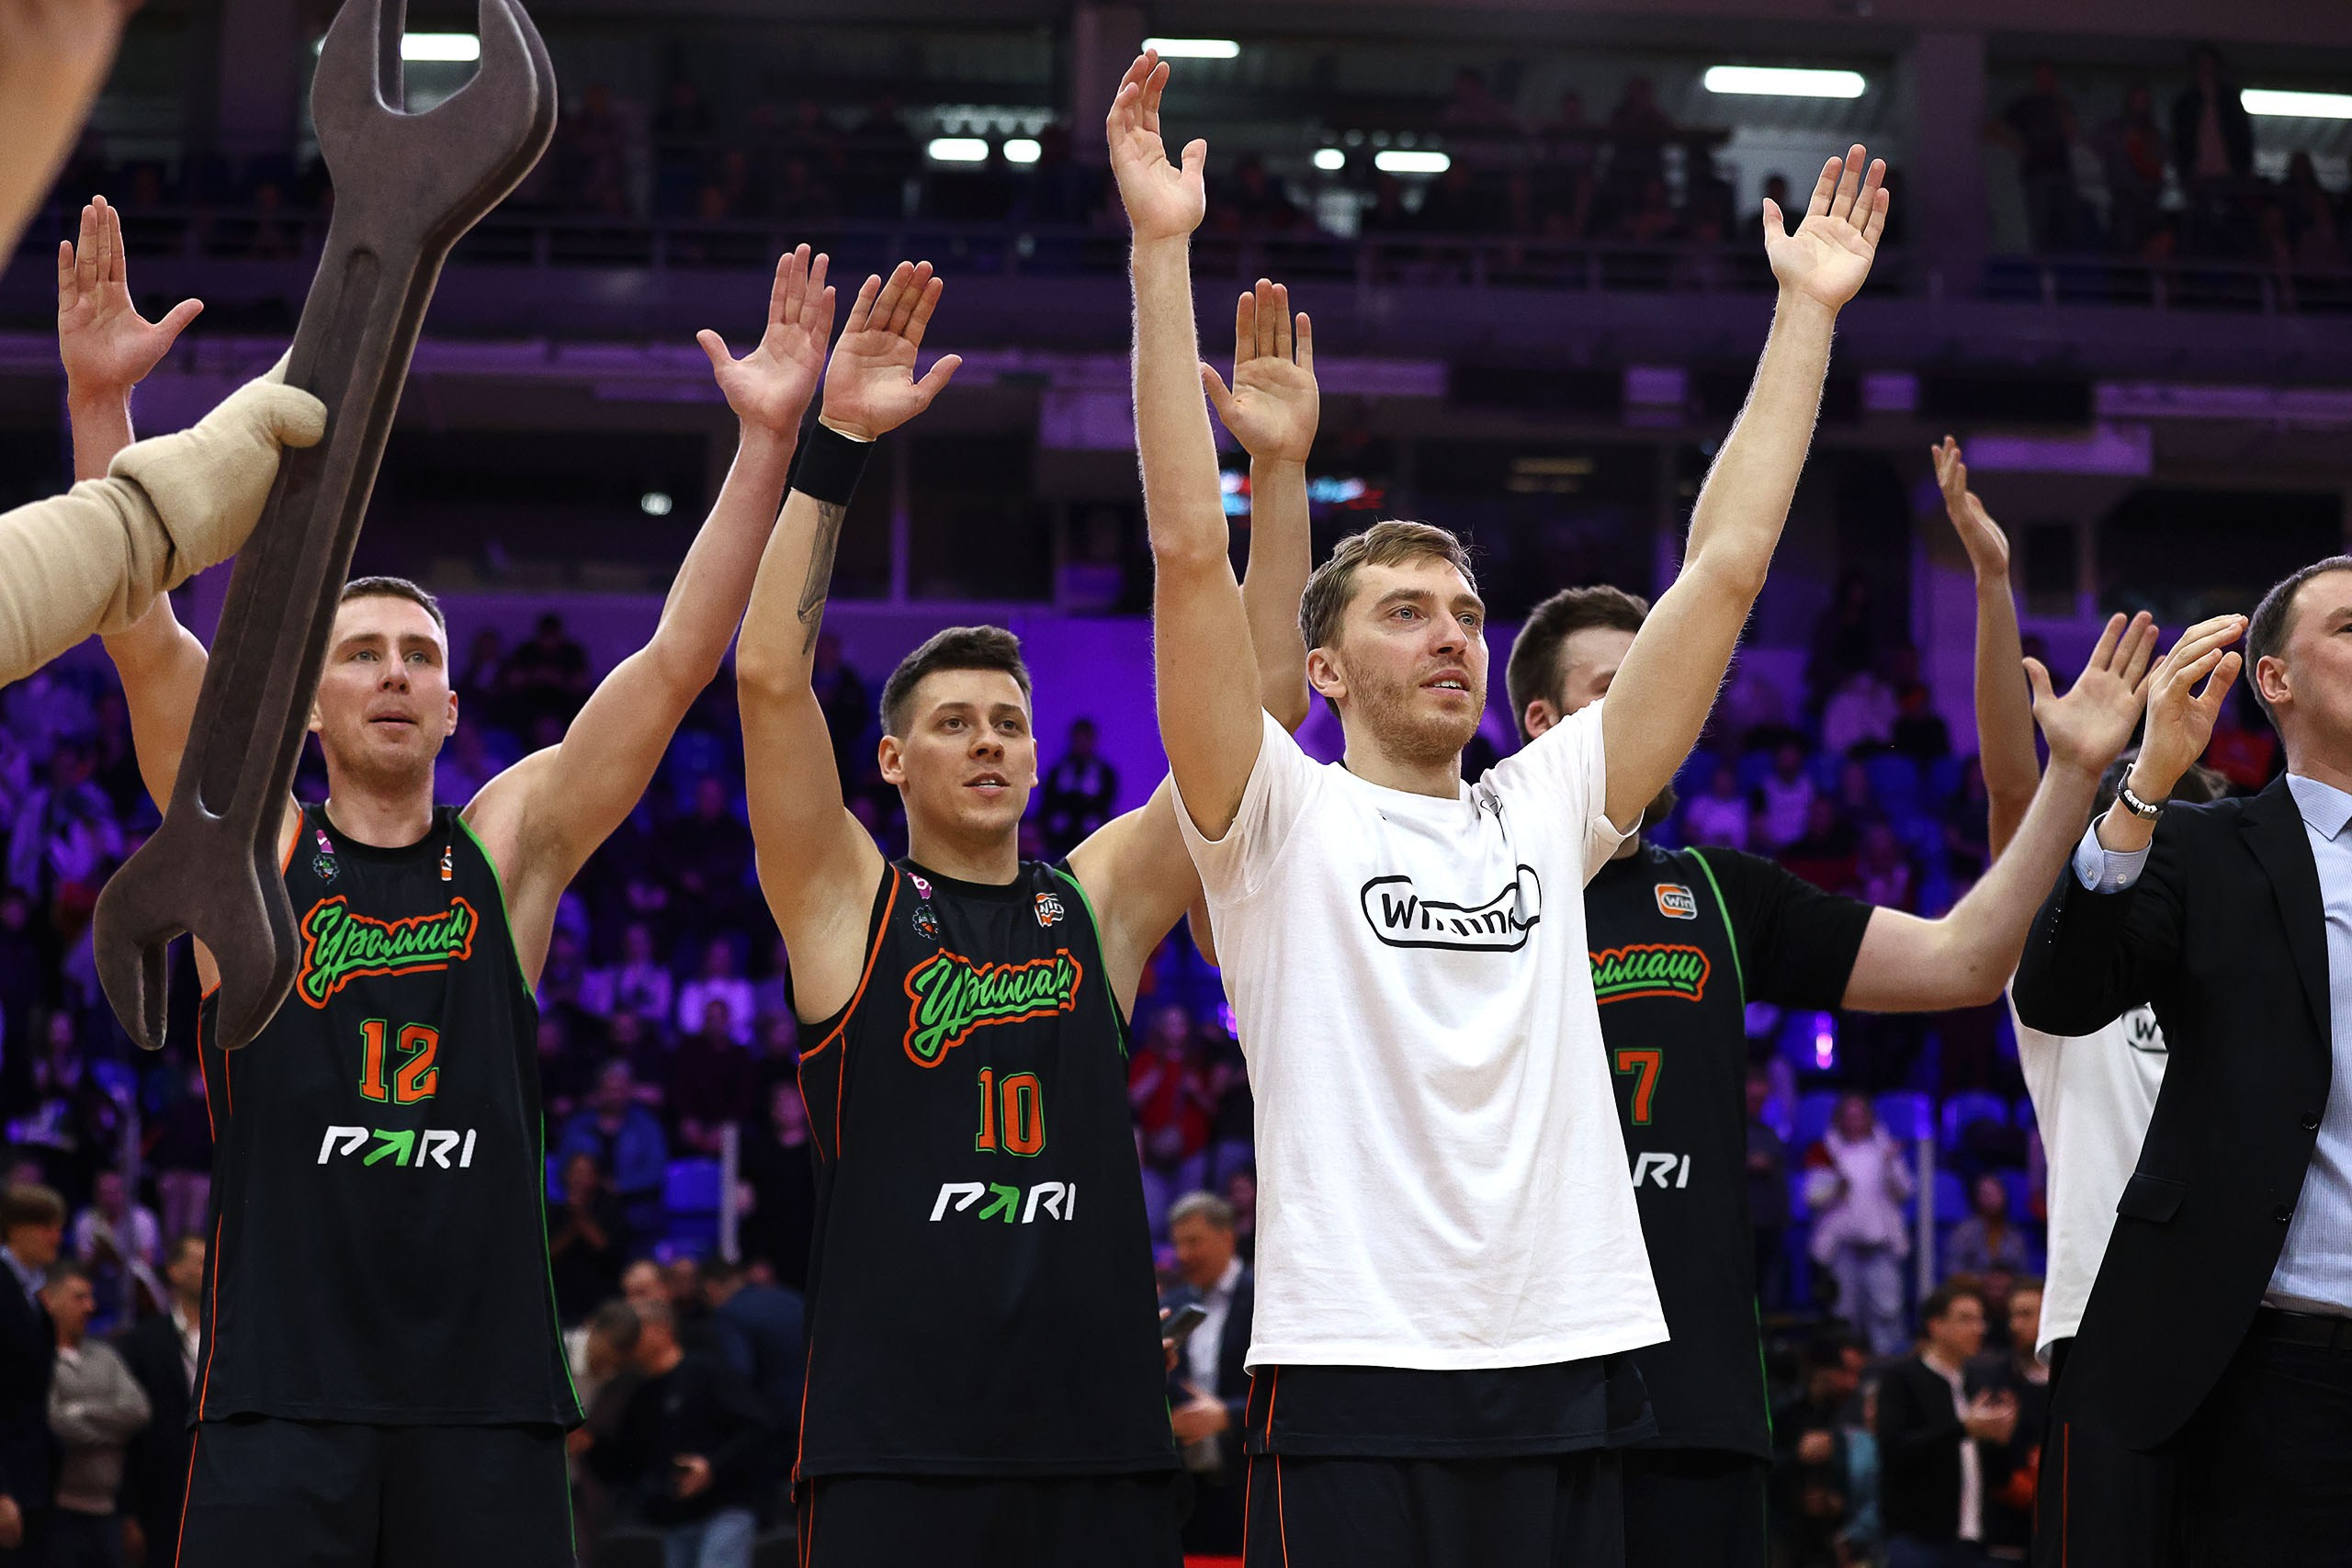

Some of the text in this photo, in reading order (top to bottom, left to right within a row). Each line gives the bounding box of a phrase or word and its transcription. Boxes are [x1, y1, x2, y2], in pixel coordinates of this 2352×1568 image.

[359, 1018, 439, 1105] 12
[1614, 1048, 1663, 1125] 7
[975, 1066, 1046, 1157] 10
[317, 1125, 476, 1169] PARI
[1633, 1152, 1690, 1189] RI
[929, 1181, 1076, 1224] PARI
